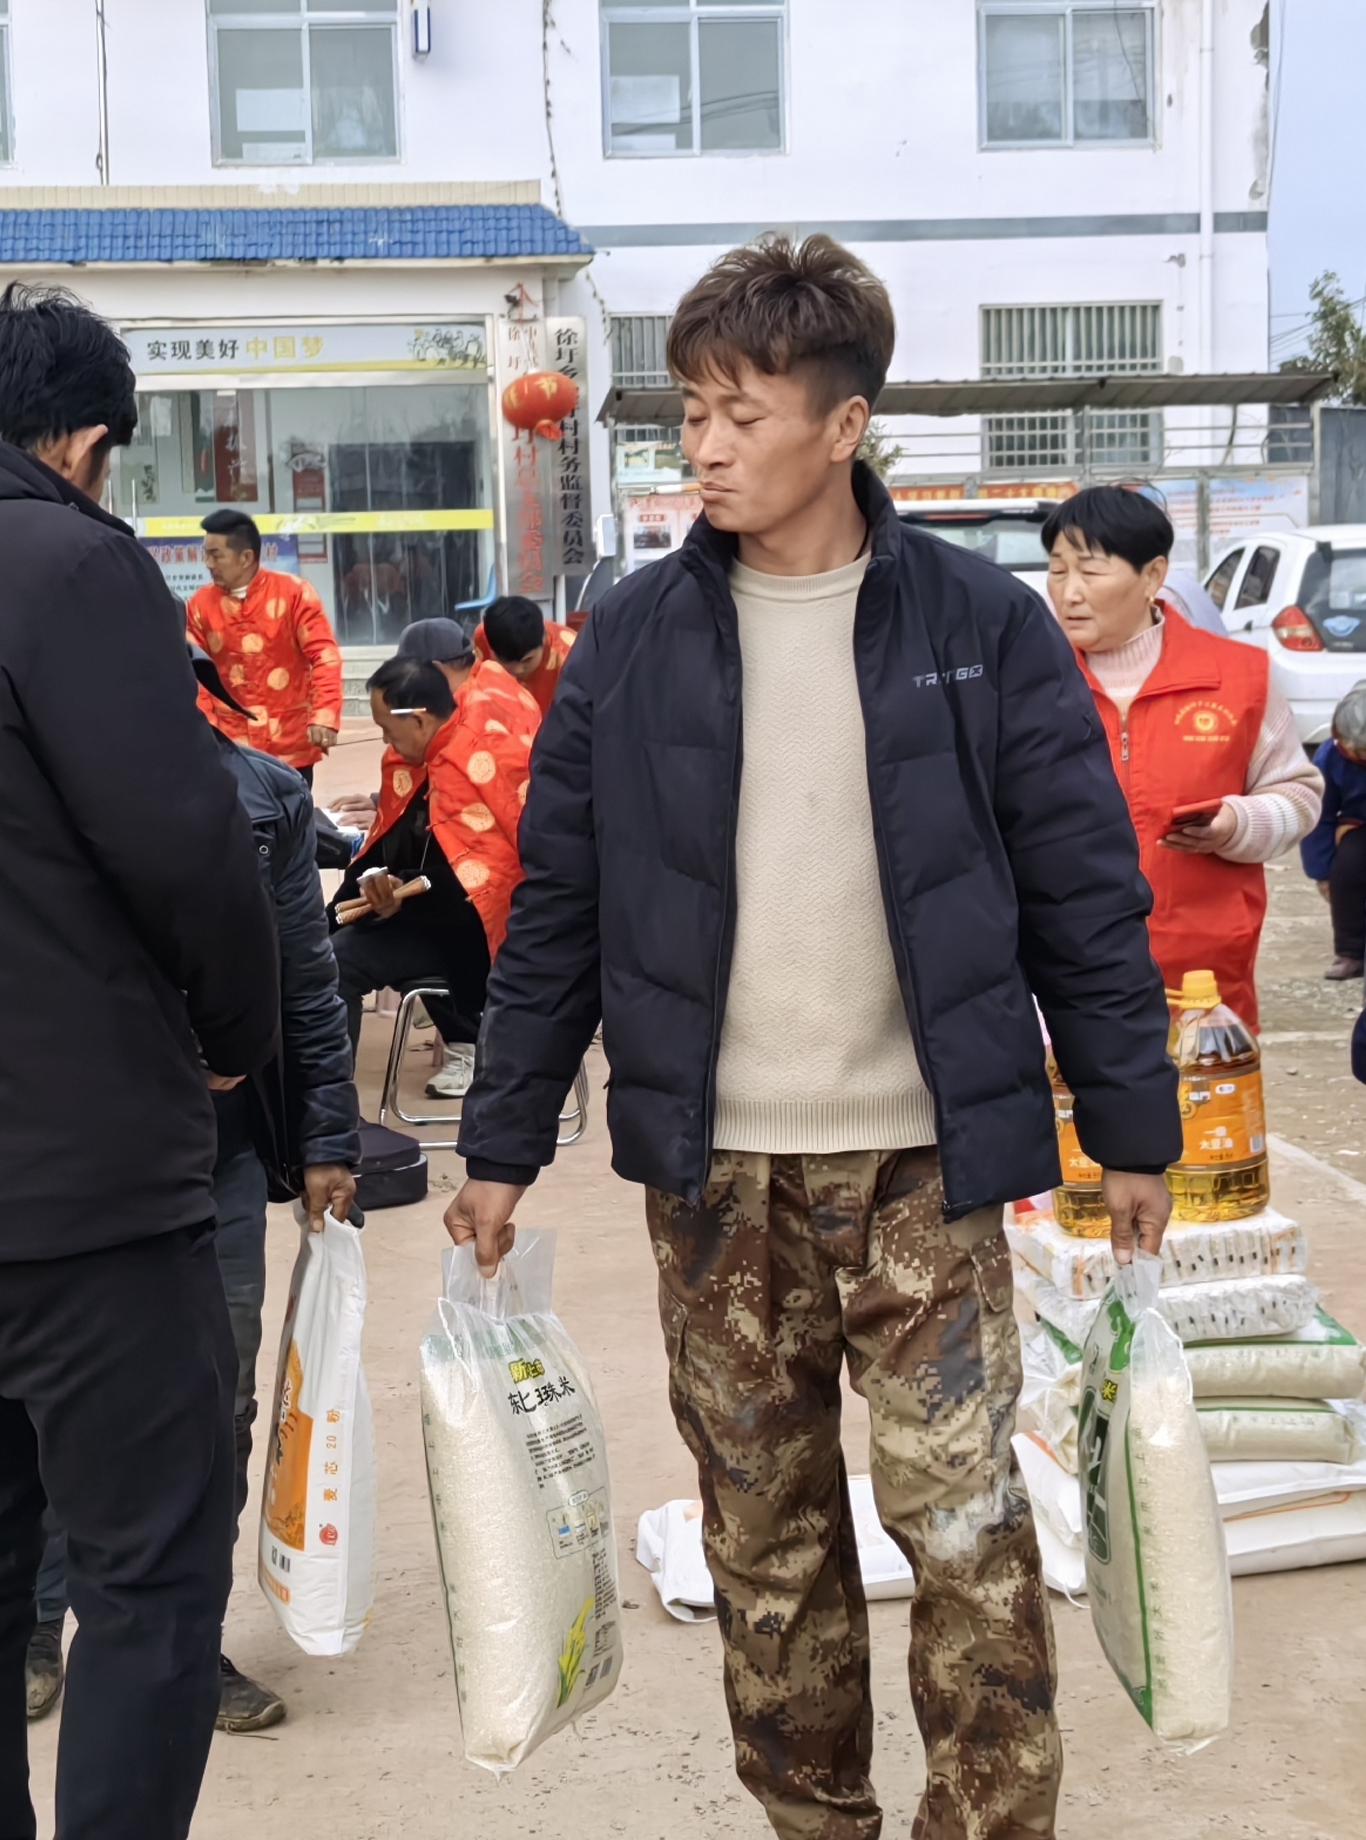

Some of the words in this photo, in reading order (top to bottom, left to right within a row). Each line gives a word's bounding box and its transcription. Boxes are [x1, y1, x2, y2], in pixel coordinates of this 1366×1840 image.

[555, 327, 585, 565] 徐圩乡村村务监督委员会
